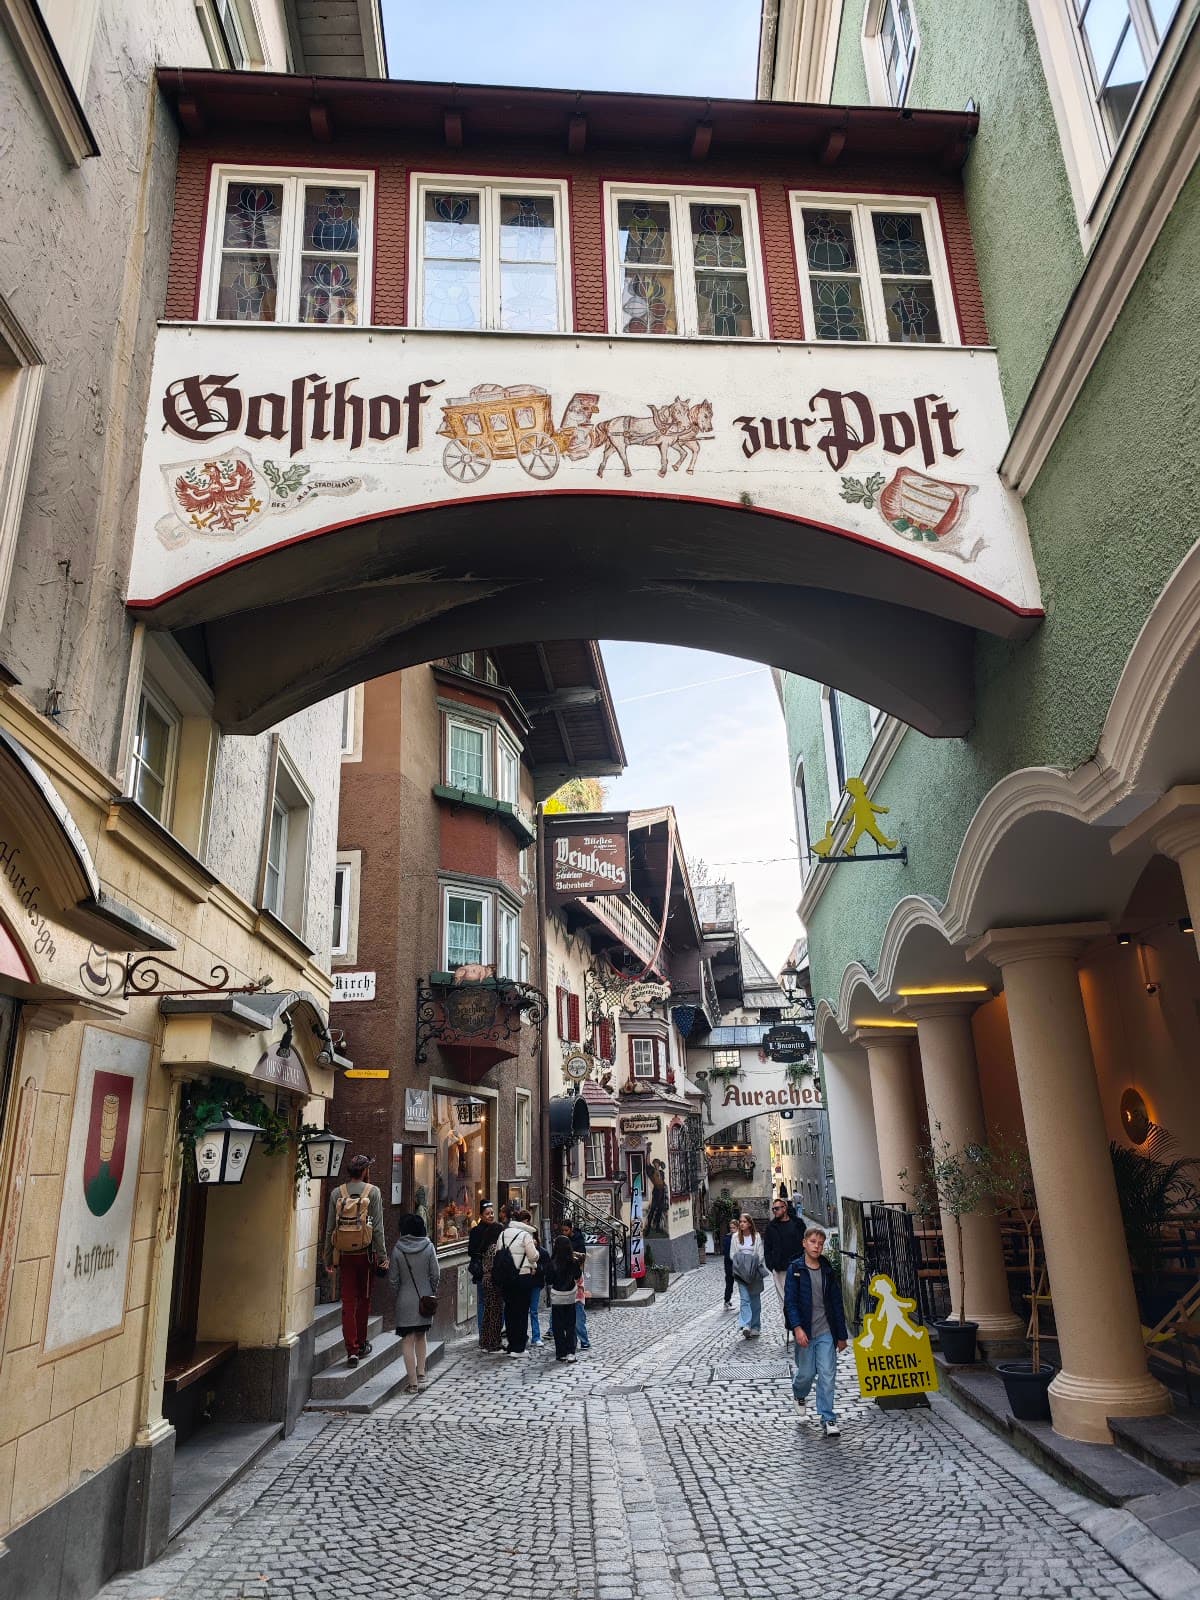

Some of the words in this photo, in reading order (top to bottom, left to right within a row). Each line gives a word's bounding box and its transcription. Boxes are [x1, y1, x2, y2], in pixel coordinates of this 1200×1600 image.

[733, 415, 816, 459] zur
[809, 388, 964, 472] Post
[556, 837, 626, 884] Weinhaus
[632, 1187, 642, 1273] PIZZA
[864, 1371, 931, 1392] SPAZIERT!
[867, 1353, 922, 1372] HEREIN-
